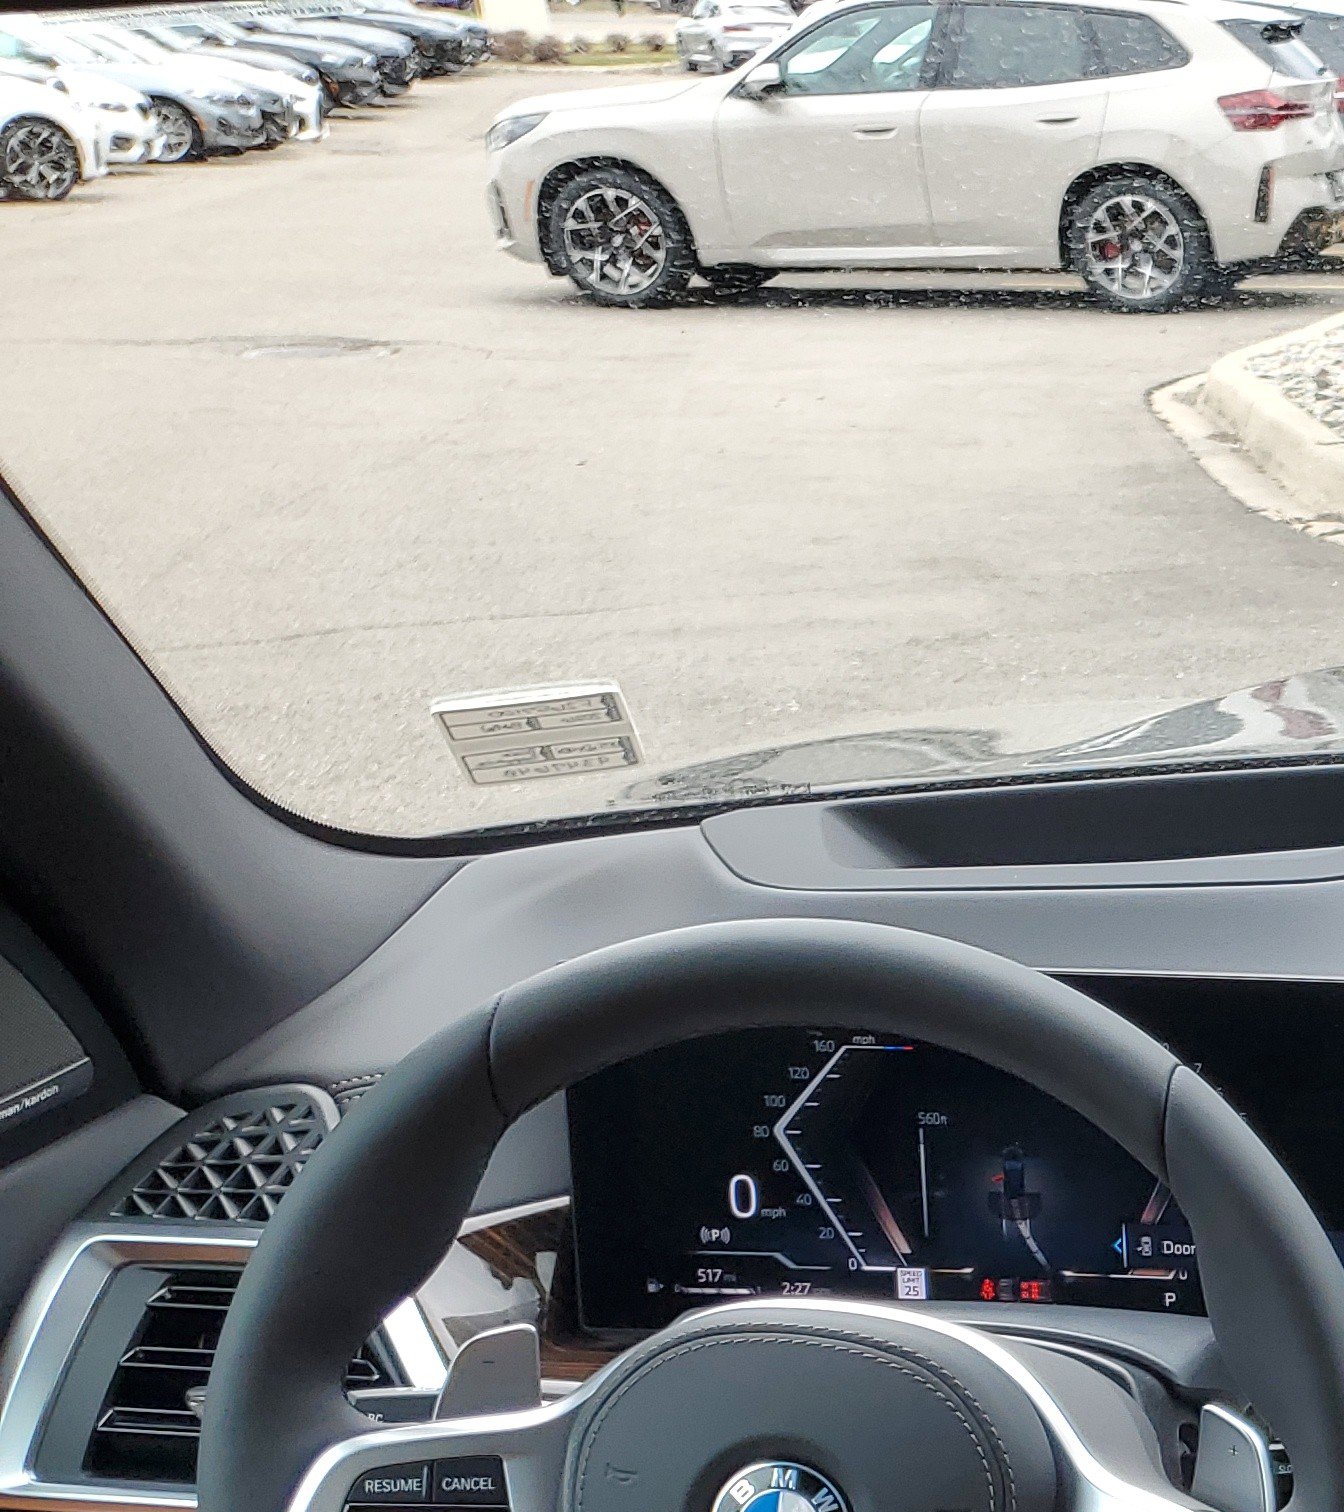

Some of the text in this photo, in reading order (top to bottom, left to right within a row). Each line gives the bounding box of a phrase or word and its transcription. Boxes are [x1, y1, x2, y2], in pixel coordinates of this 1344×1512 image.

[813, 1039, 836, 1053] 160
[852, 1034, 875, 1045] mph
[788, 1067, 810, 1080] 120
[764, 1095, 786, 1107] 100
[753, 1126, 770, 1138] 80
[773, 1159, 789, 1172] 60
[729, 1174, 757, 1218] 0
[796, 1193, 812, 1206] 40
[761, 1208, 786, 1220] mph
[818, 1227, 835, 1239] 20
[1162, 1240, 1196, 1255] Door
[848, 1258, 858, 1270] 0
[697, 1268, 723, 1283] 517
[780, 1281, 811, 1295] 2:27
[904, 1285, 920, 1297] 25
[1164, 1293, 1176, 1307] P
[365, 1478, 421, 1493] RESUME
[442, 1477, 495, 1490] CANCEL
